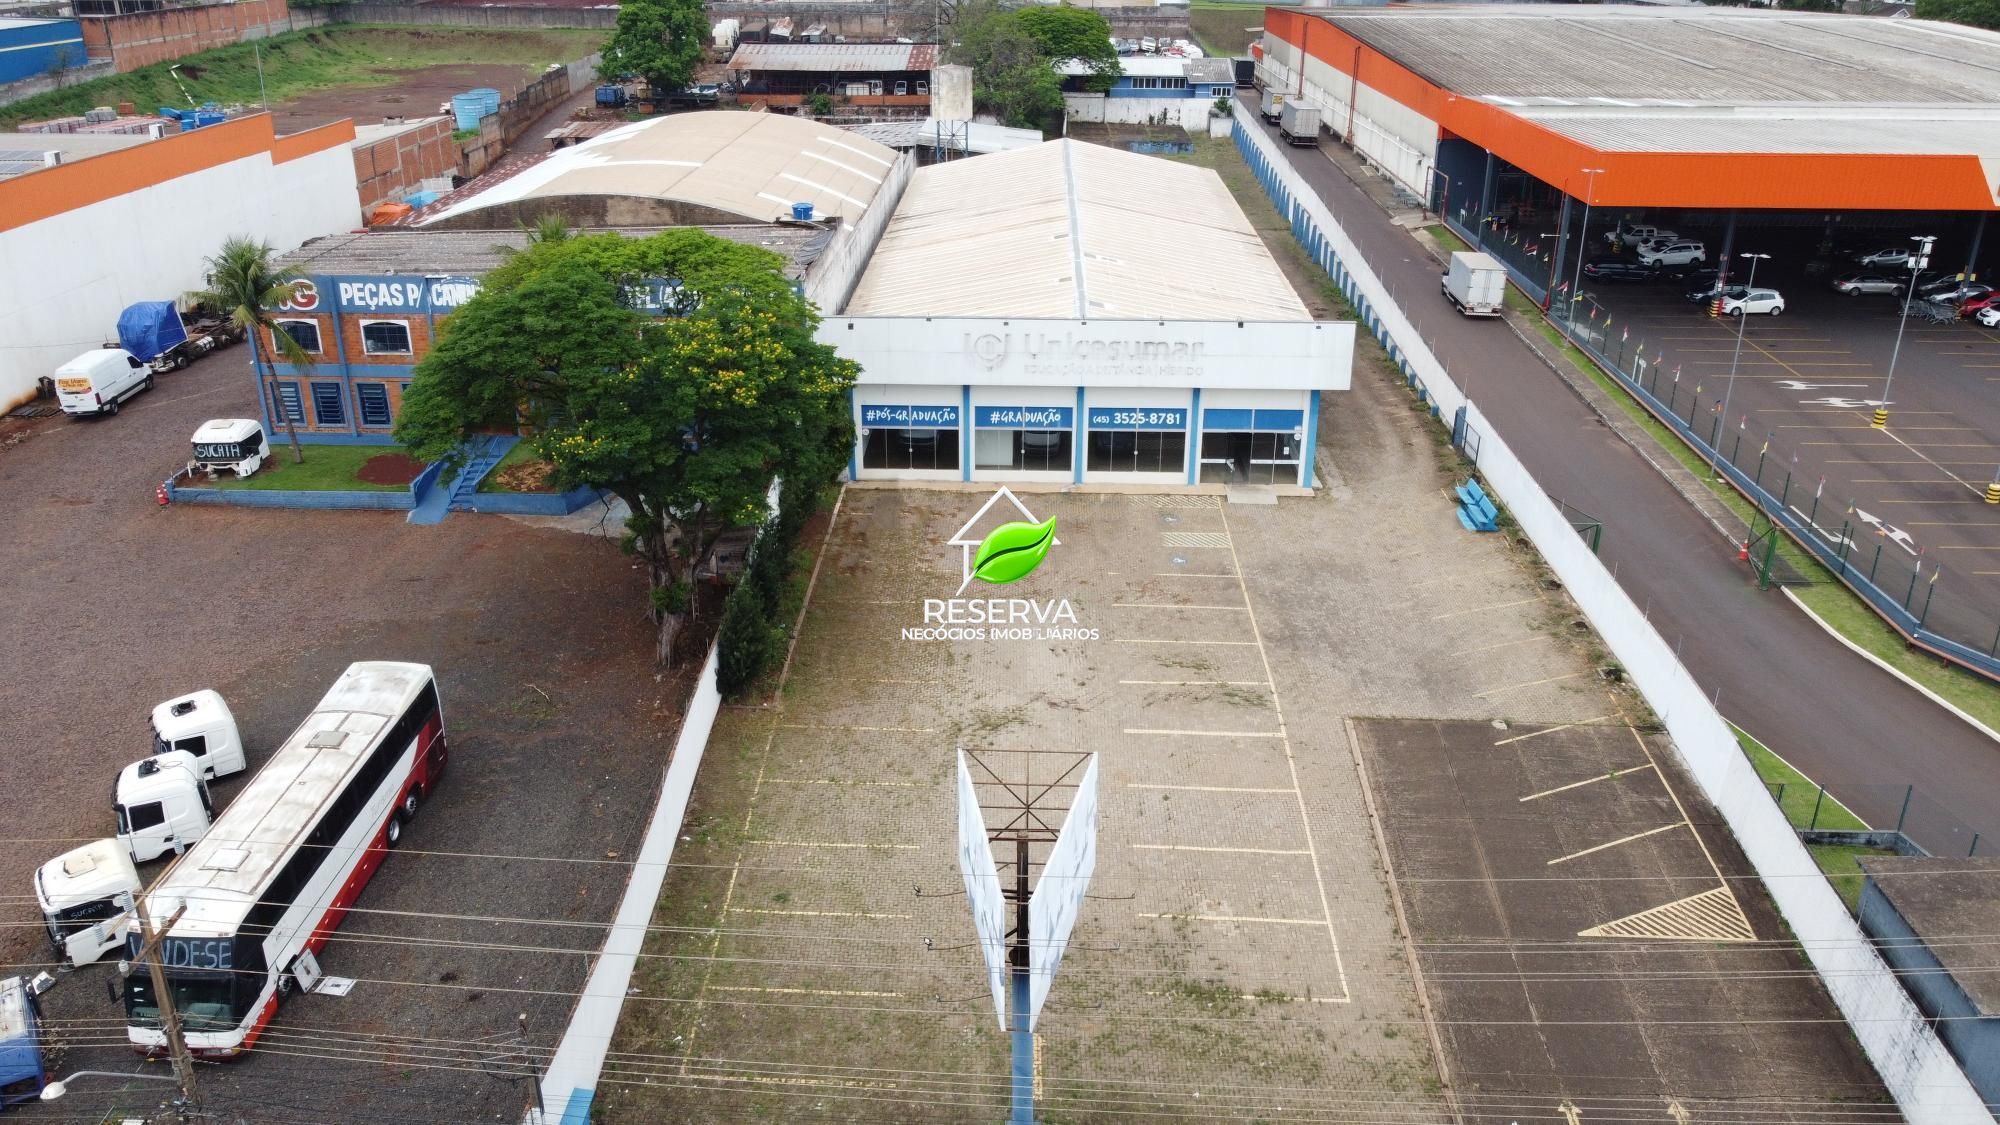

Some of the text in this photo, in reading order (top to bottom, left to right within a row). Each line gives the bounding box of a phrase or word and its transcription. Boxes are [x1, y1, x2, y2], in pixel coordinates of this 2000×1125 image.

[339, 283, 404, 310] PEÇAS
[406, 283, 423, 308] P/
[866, 407, 956, 424] #PÓS-GRADUAÇÃO
[990, 408, 1061, 427] #GRADUAÇÃO
[1093, 415, 1110, 424] (45)
[196, 443, 240, 458] SUCATA
[129, 935, 233, 969] VNDE-SE
